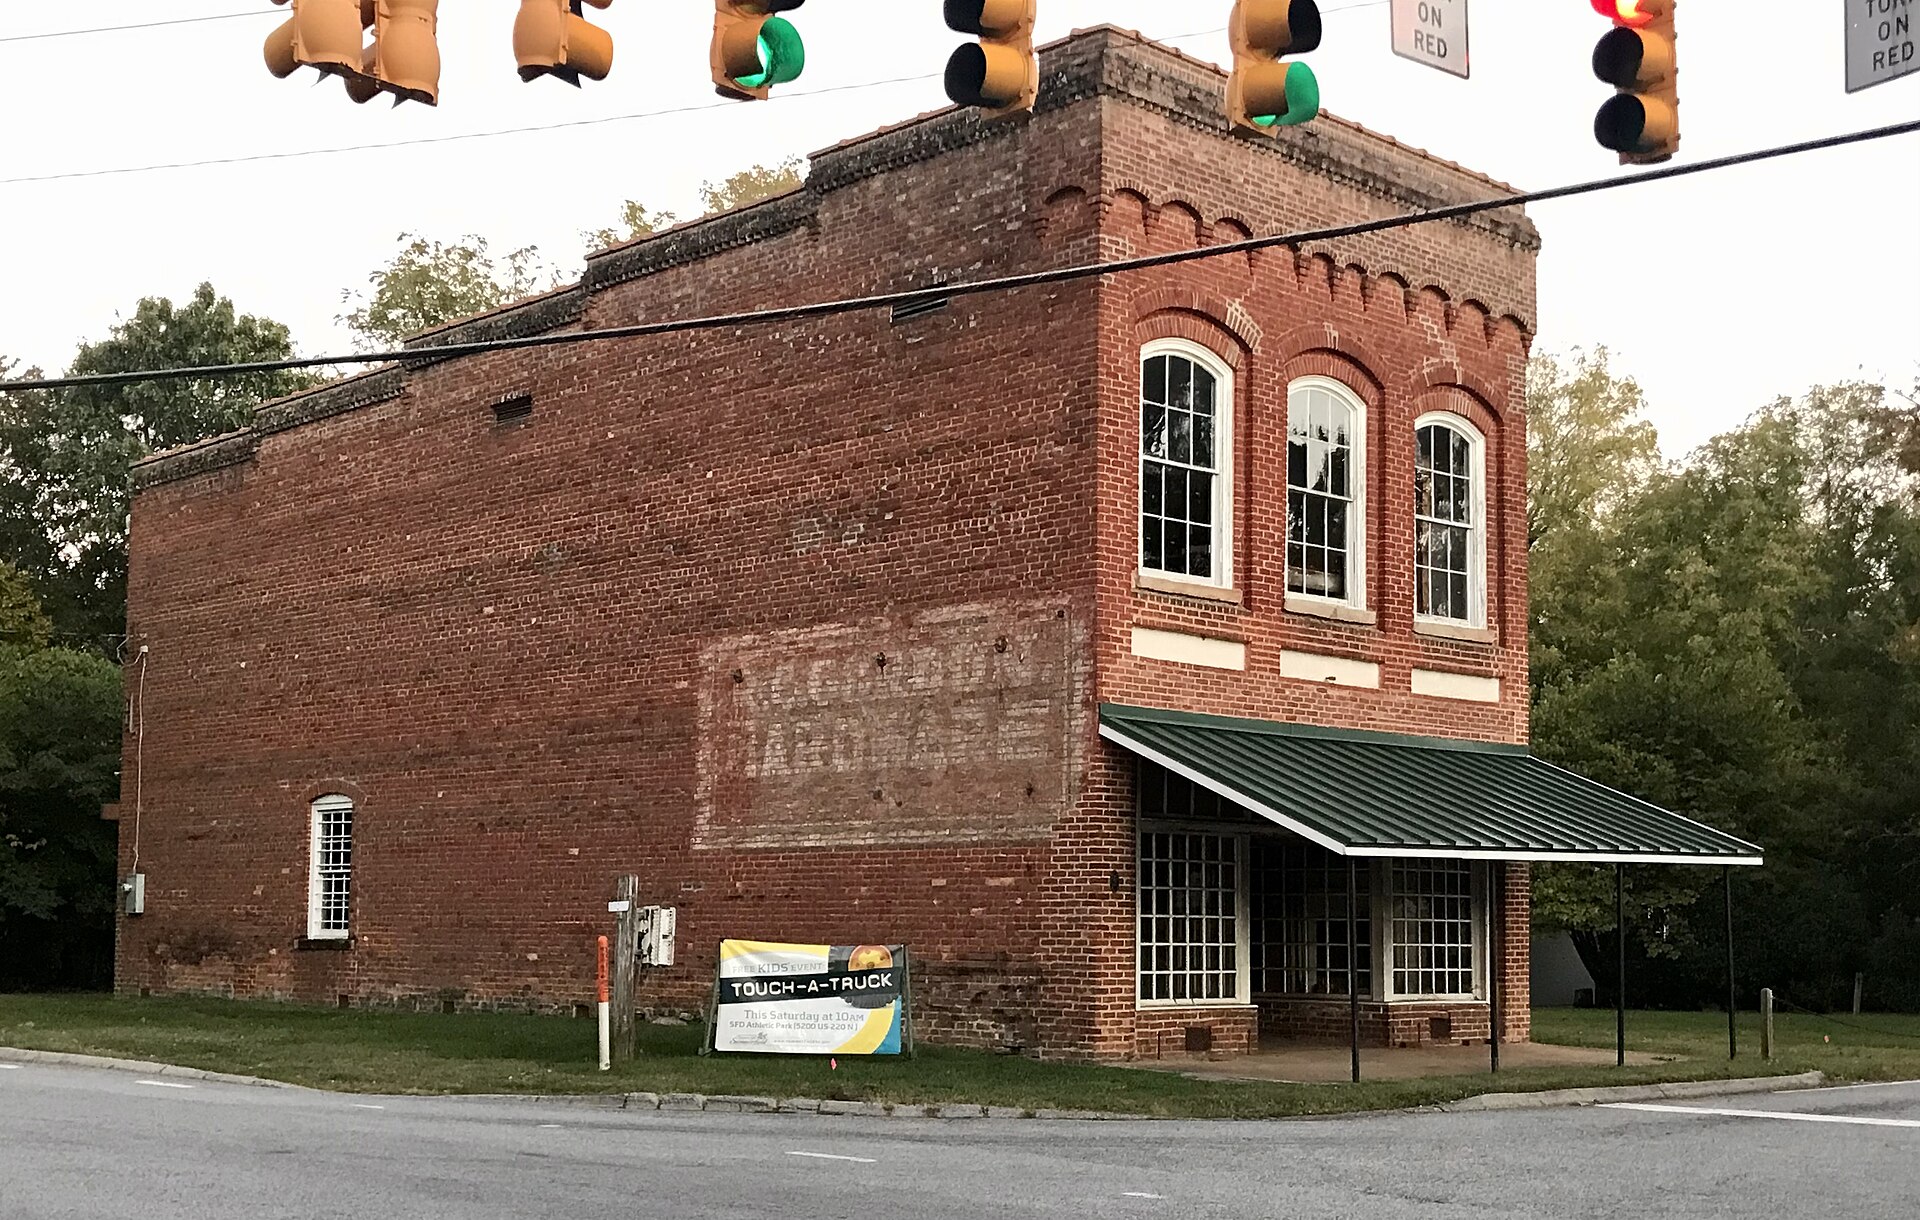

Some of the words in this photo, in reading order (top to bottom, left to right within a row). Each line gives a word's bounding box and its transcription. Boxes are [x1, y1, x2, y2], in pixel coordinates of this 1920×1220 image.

[1418, 2, 1441, 29] ON
[1865, 0, 1913, 18] TU
[1878, 14, 1908, 41] ON
[1414, 29, 1447, 58] RED
[1873, 41, 1914, 72] RED
[791, 963, 822, 972] EVENT
[731, 973, 892, 997] TOUCH-A-TRUCK
[729, 1021, 745, 1029] SFD
[746, 1021, 774, 1029] Athletic
[744, 1010, 767, 1020] This
[769, 1011, 819, 1022] Saturday
[821, 1012, 833, 1021] at
[835, 1012, 864, 1021] 10AM
